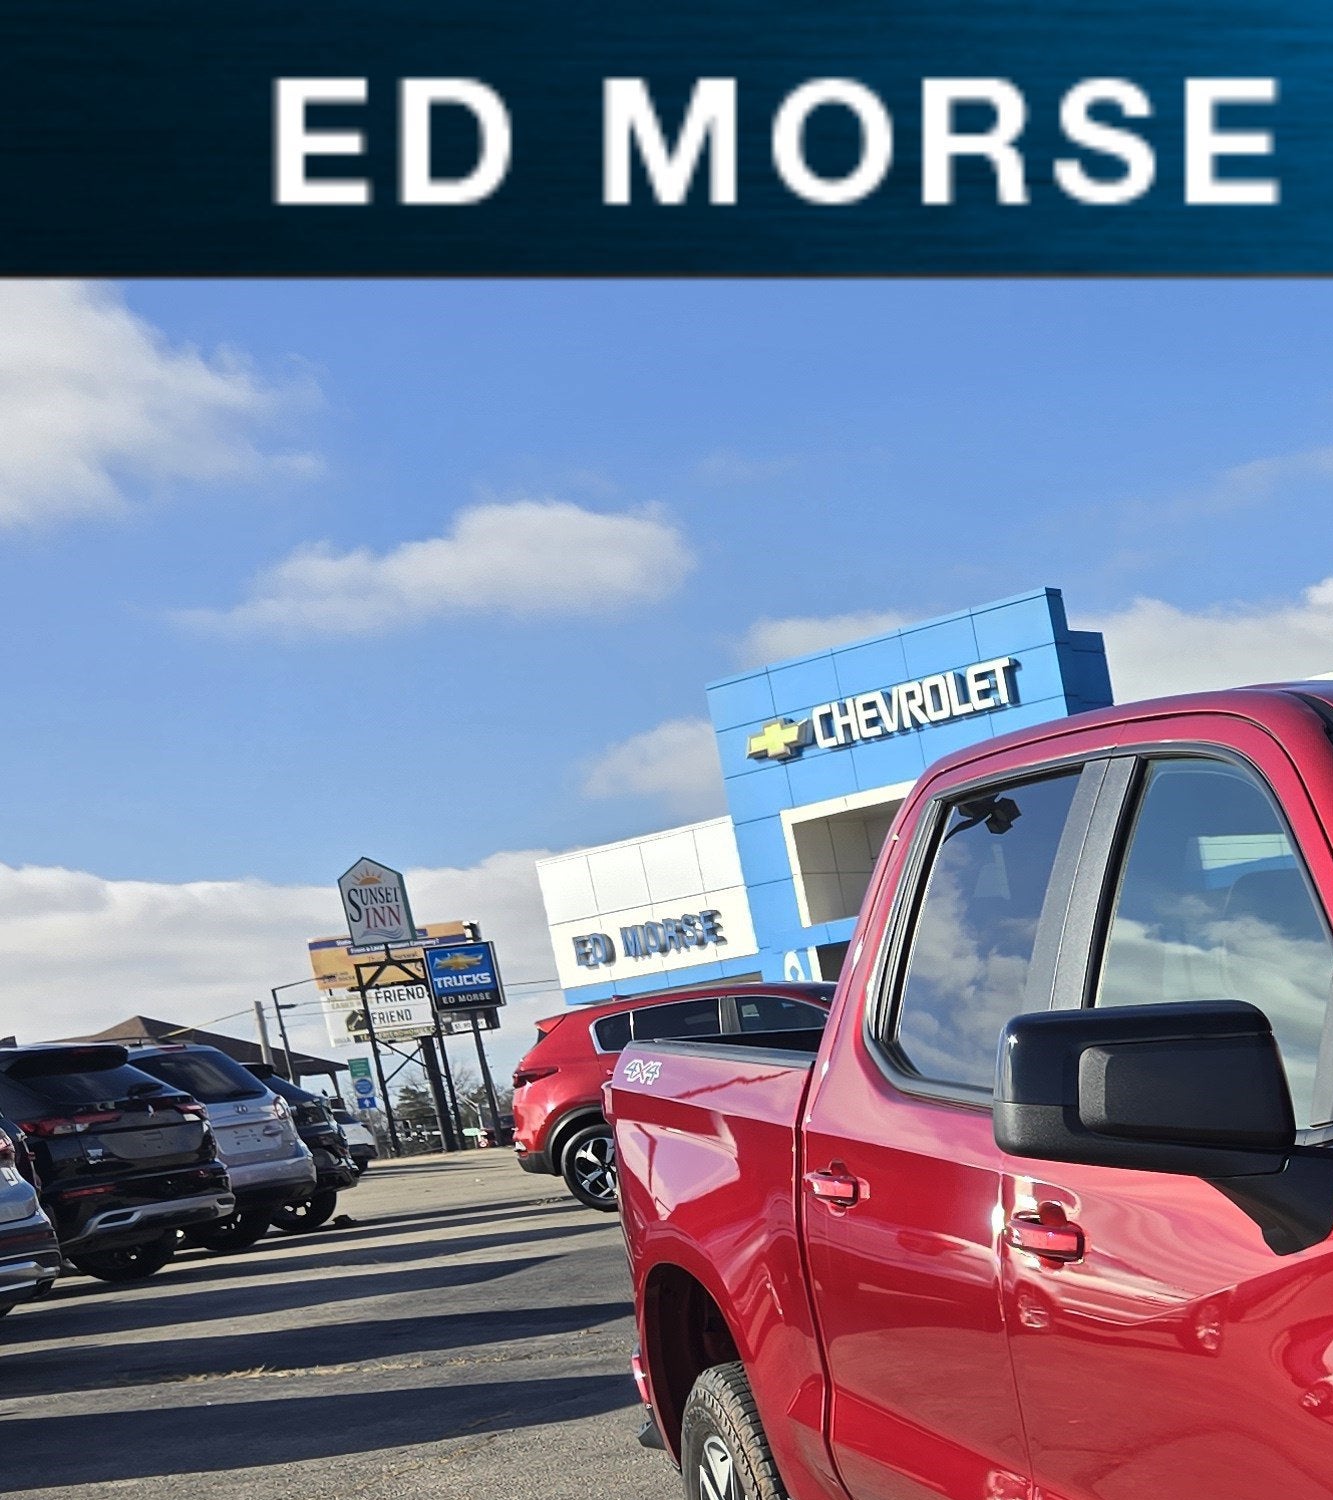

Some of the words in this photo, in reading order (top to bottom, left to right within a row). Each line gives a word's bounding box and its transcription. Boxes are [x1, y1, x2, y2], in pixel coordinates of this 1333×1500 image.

[811, 656, 1016, 750] CHEVROLET
[347, 887, 400, 923] SUNSET
[365, 904, 402, 929] INN
[572, 932, 614, 969] ED
[619, 909, 724, 960] MORSE
[433, 972, 492, 989] TRUCKS
[375, 986, 425, 1004] FRIEND
[441, 995, 456, 1005] ED
[460, 991, 492, 1003] MORSE
[371, 1008, 412, 1025] FRIEND
